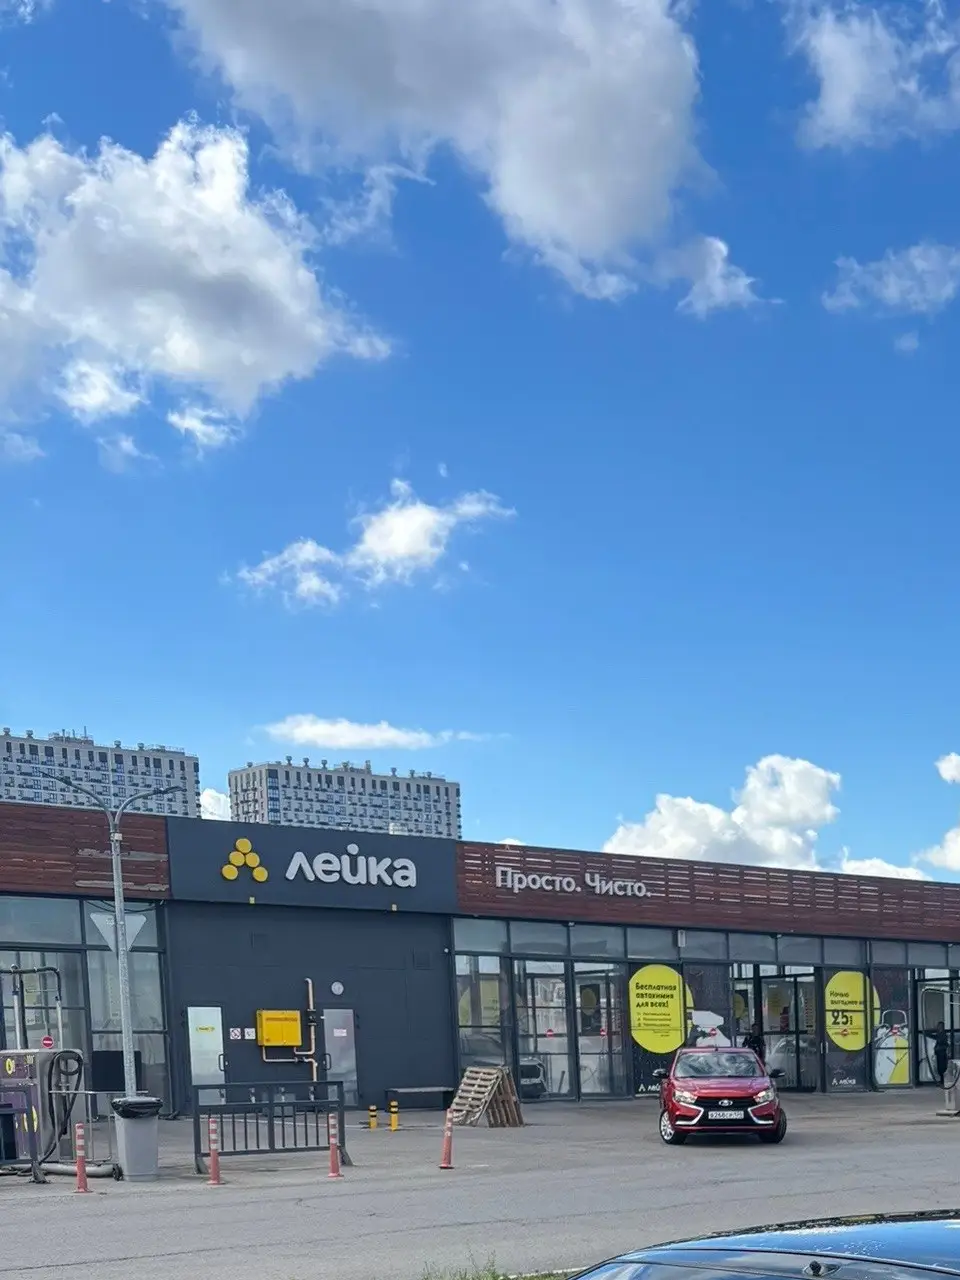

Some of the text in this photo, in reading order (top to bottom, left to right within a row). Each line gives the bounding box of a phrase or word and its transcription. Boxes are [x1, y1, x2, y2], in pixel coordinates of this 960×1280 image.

[495, 866, 652, 897] Просто. Чисто.
[635, 982, 677, 991] Бесплатная
